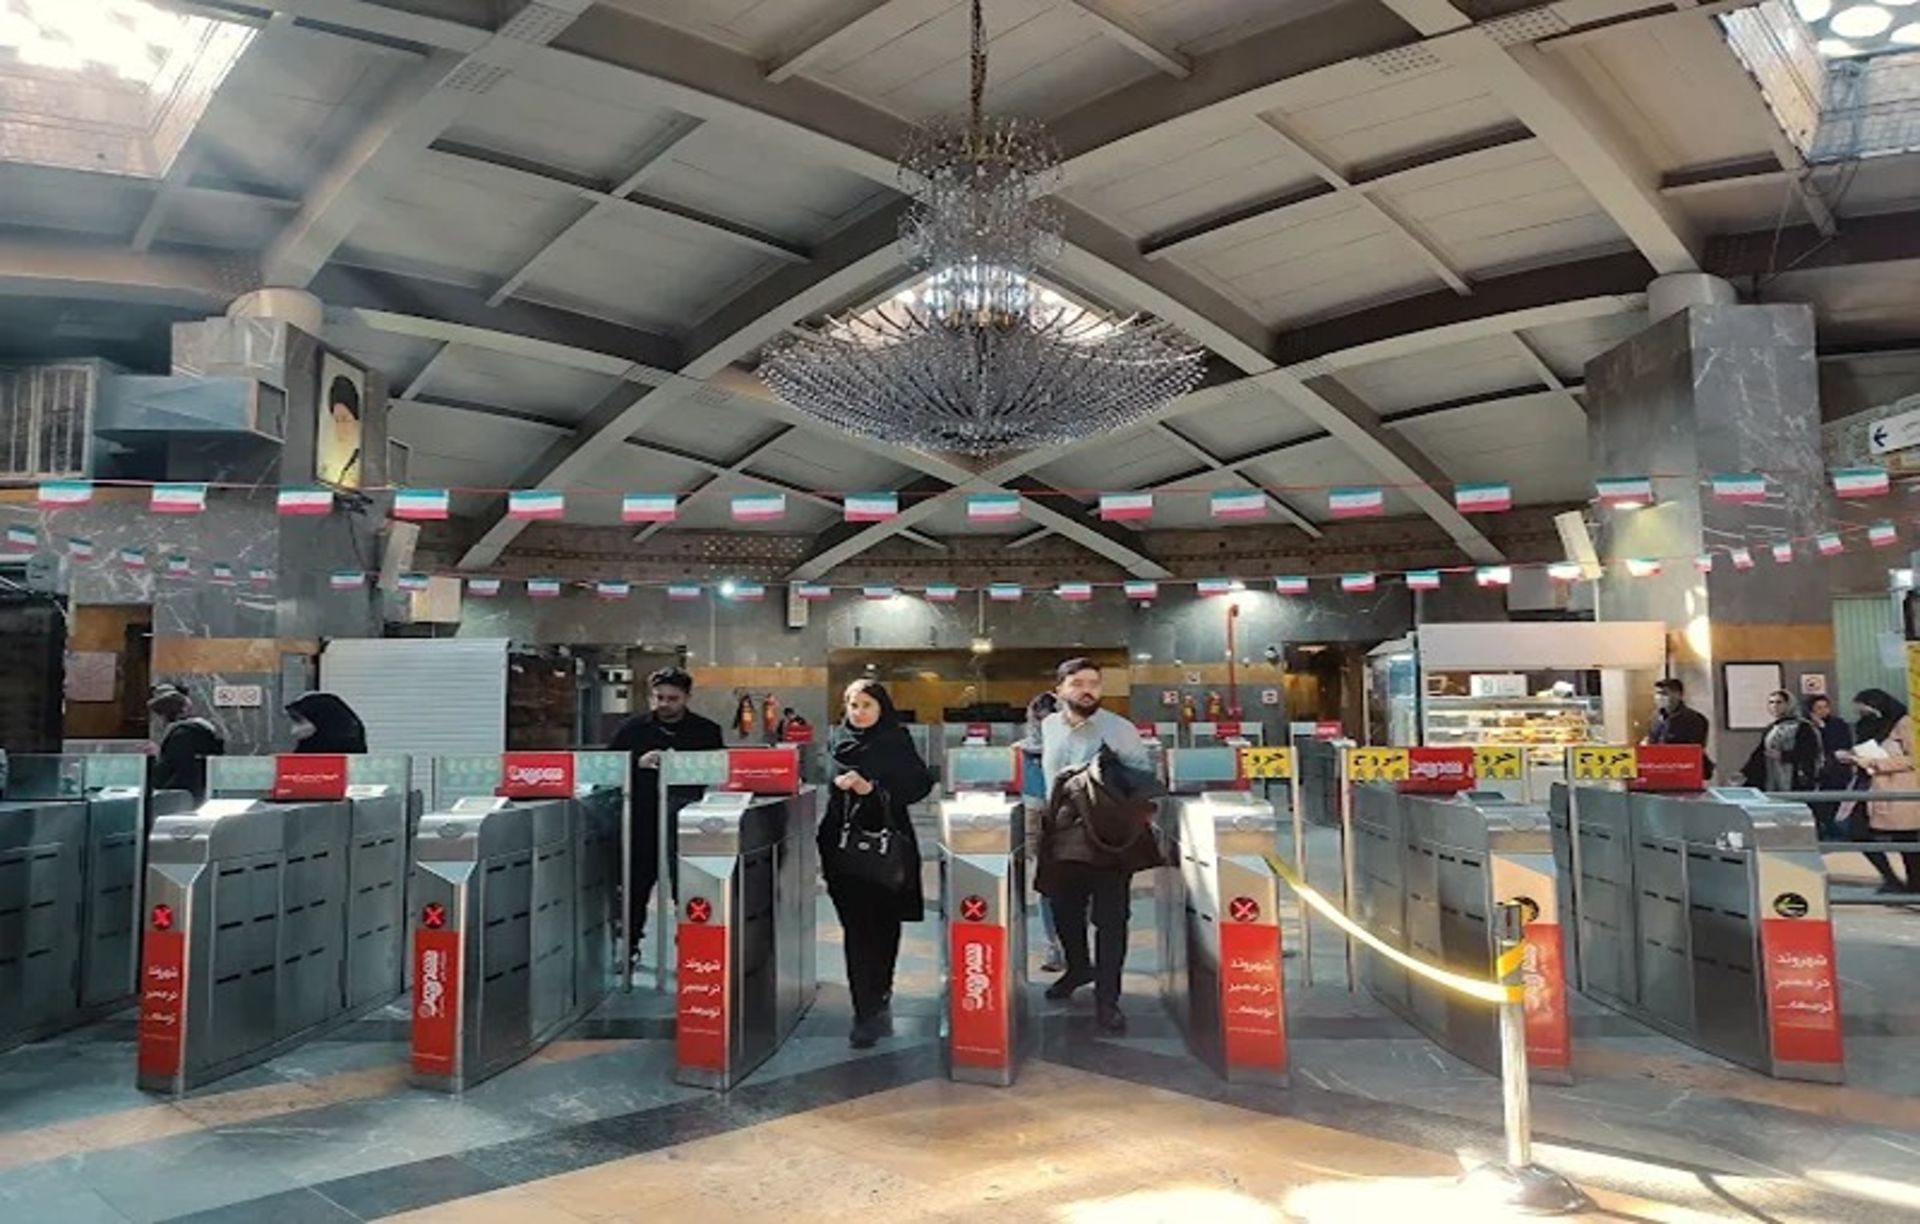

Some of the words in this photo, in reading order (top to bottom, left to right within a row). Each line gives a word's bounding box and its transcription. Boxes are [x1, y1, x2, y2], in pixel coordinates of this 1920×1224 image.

[1579, 752, 1631, 766] خروج
[1230, 956, 1276, 973] شهروند
[1775, 951, 1828, 970] شهروند
